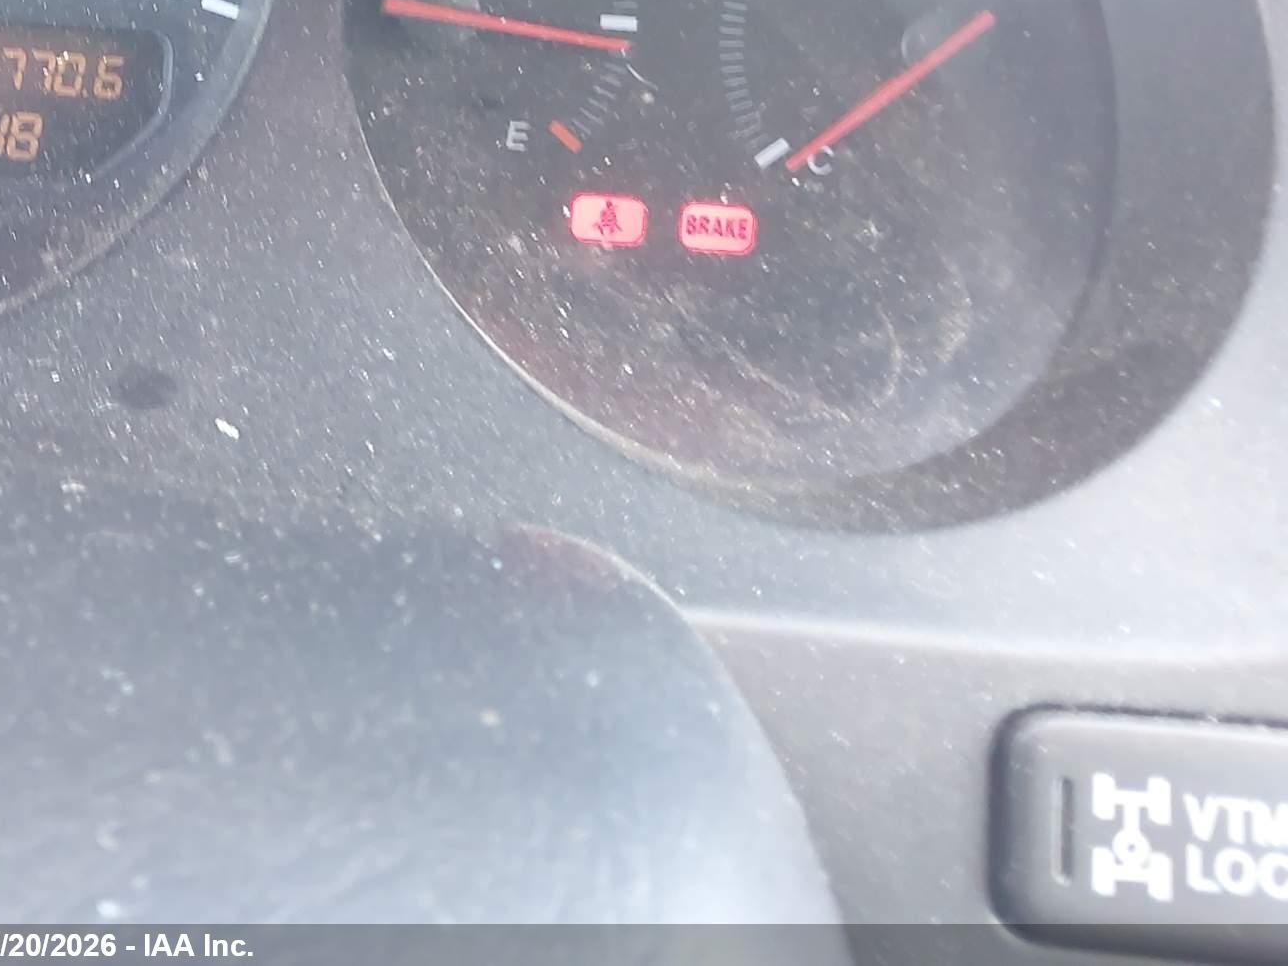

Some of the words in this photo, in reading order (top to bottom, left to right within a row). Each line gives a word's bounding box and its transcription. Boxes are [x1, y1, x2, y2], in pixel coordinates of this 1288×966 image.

[3, 47, 125, 102] 770.6
[507, 121, 530, 151] E
[807, 145, 834, 176] C
[685, 214, 750, 241] BRAKE
